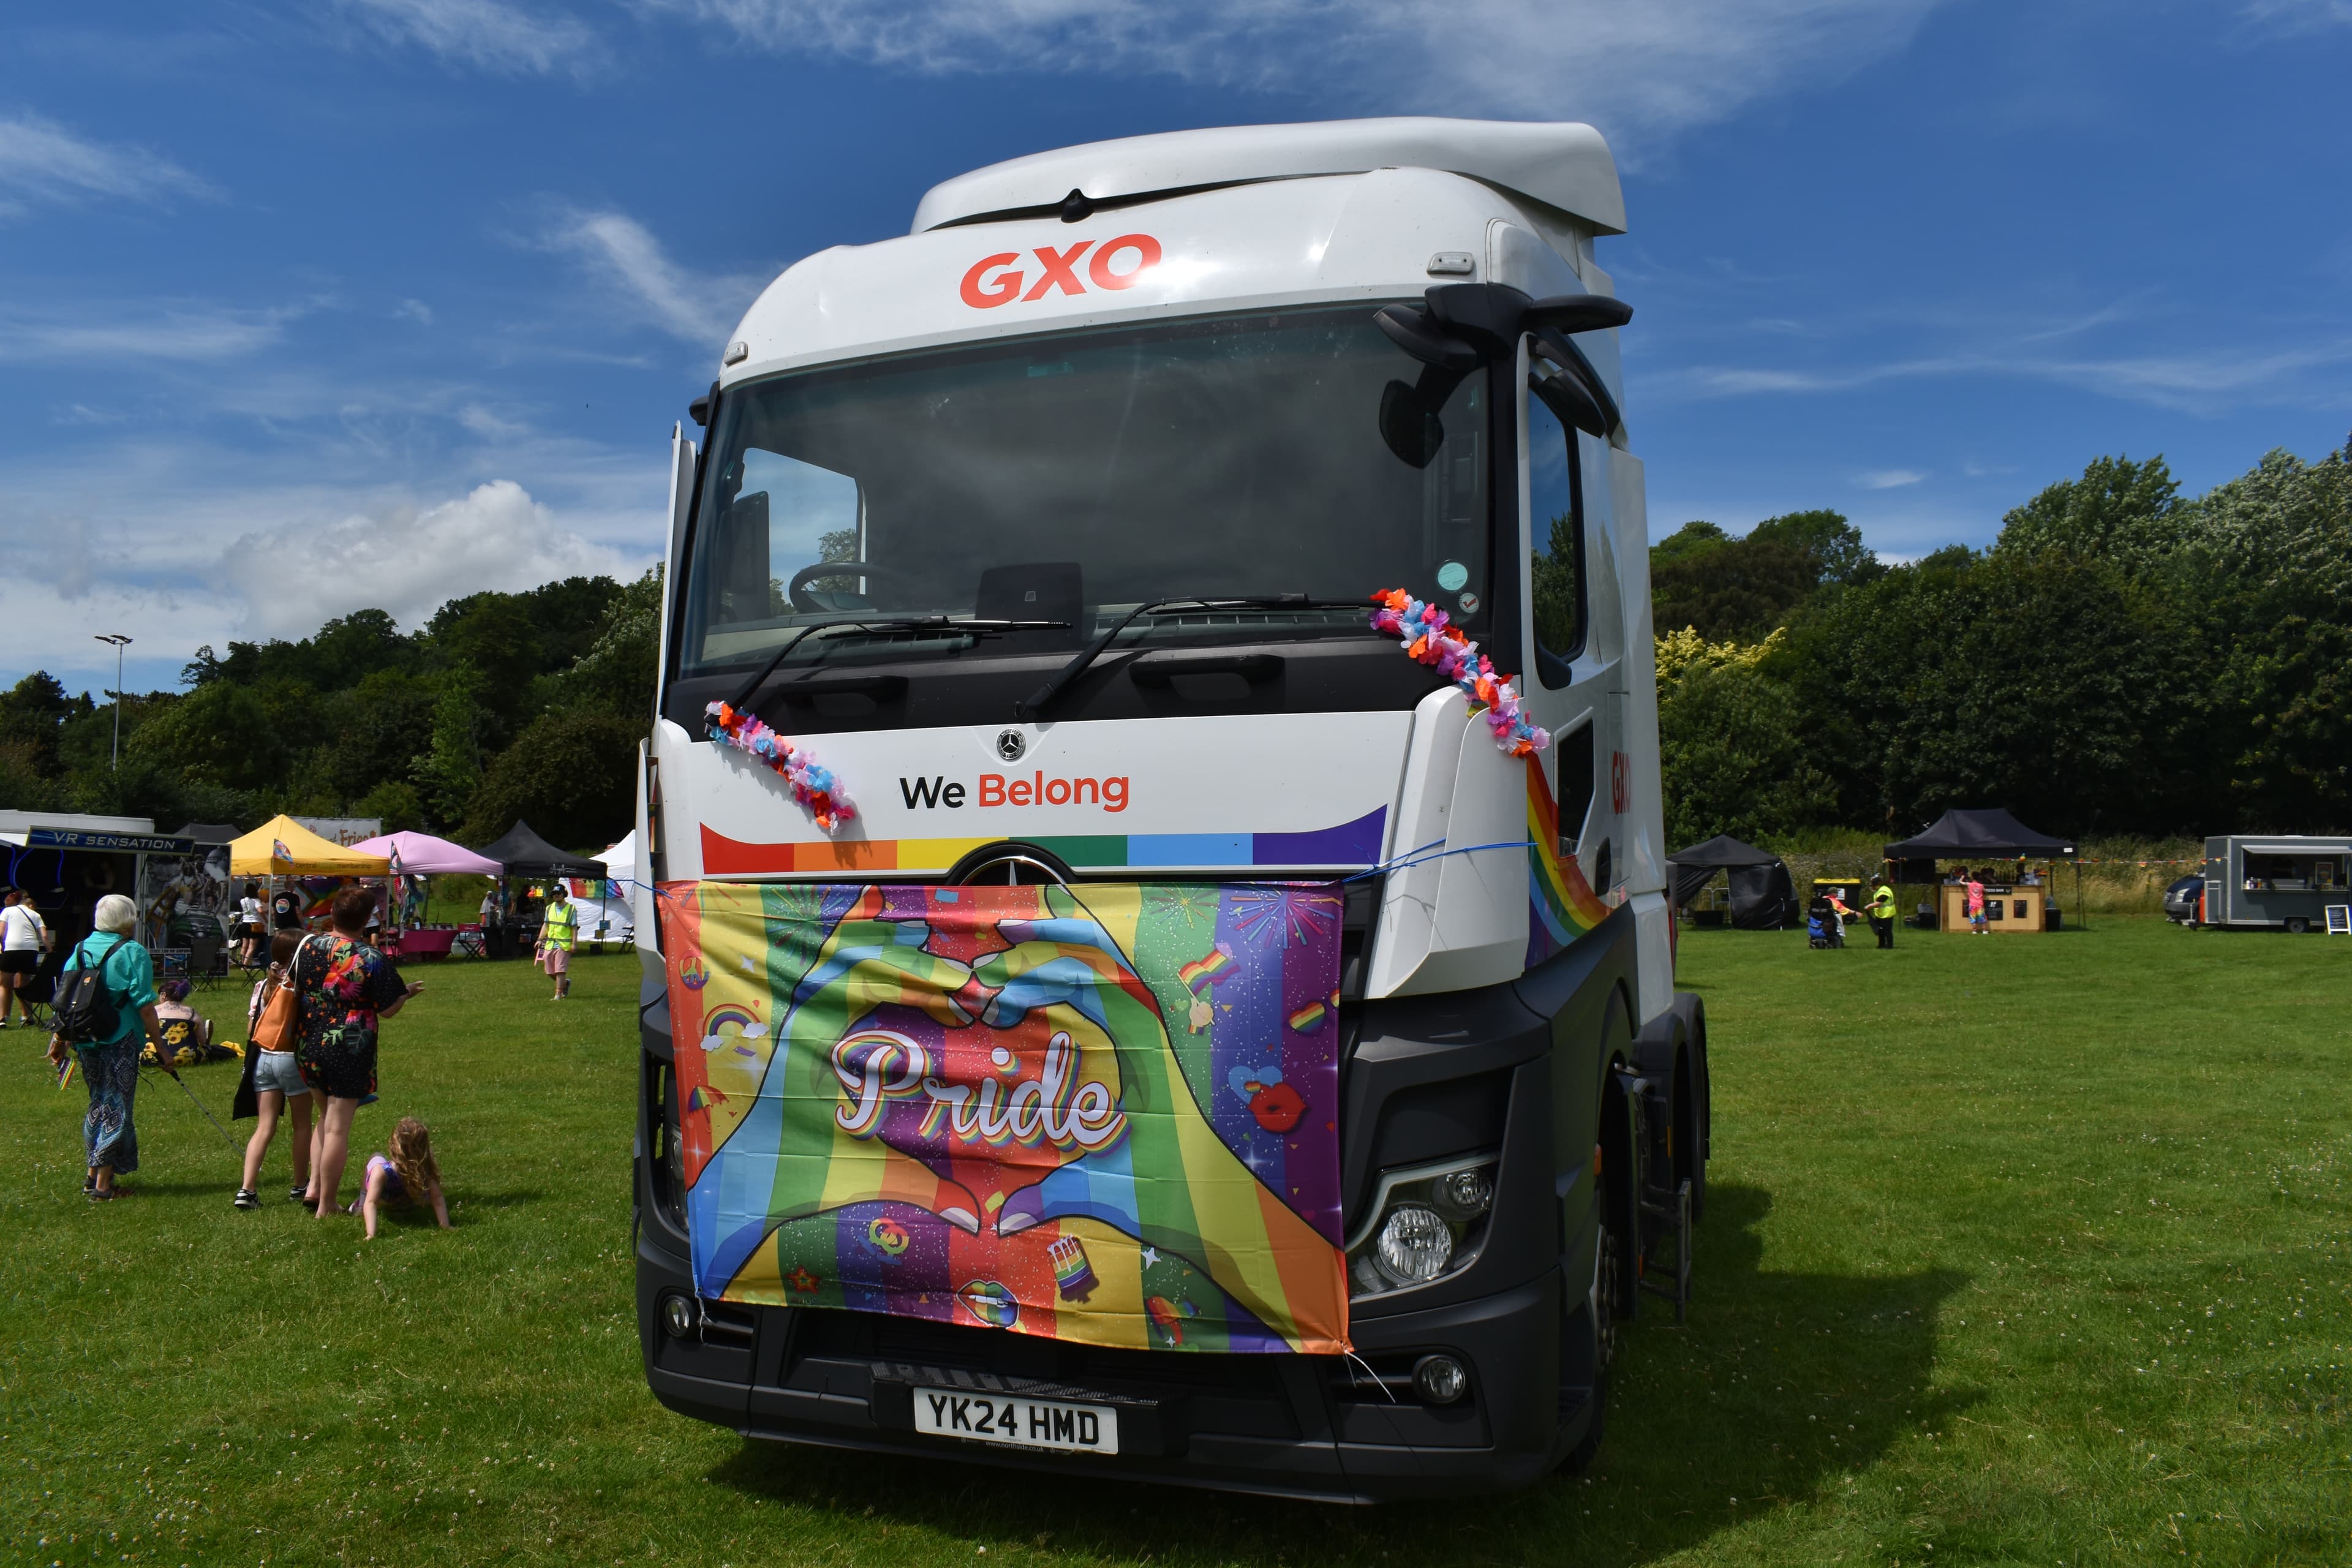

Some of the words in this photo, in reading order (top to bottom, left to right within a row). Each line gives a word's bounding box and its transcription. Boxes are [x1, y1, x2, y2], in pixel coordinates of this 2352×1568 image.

[960, 233, 1162, 309] GXO
[899, 776, 966, 809] We
[979, 771, 1129, 813] Belong
[1612, 750, 1630, 813] GXO
[53, 832, 78, 844] VR
[85, 836, 176, 850] SENSATION
[830, 1029, 1126, 1149] Pride
[928, 1393, 1017, 1436] YK24
[1028, 1406, 1099, 1446] HMD
[985, 1441, 1044, 1452] www.northside.co.uk
